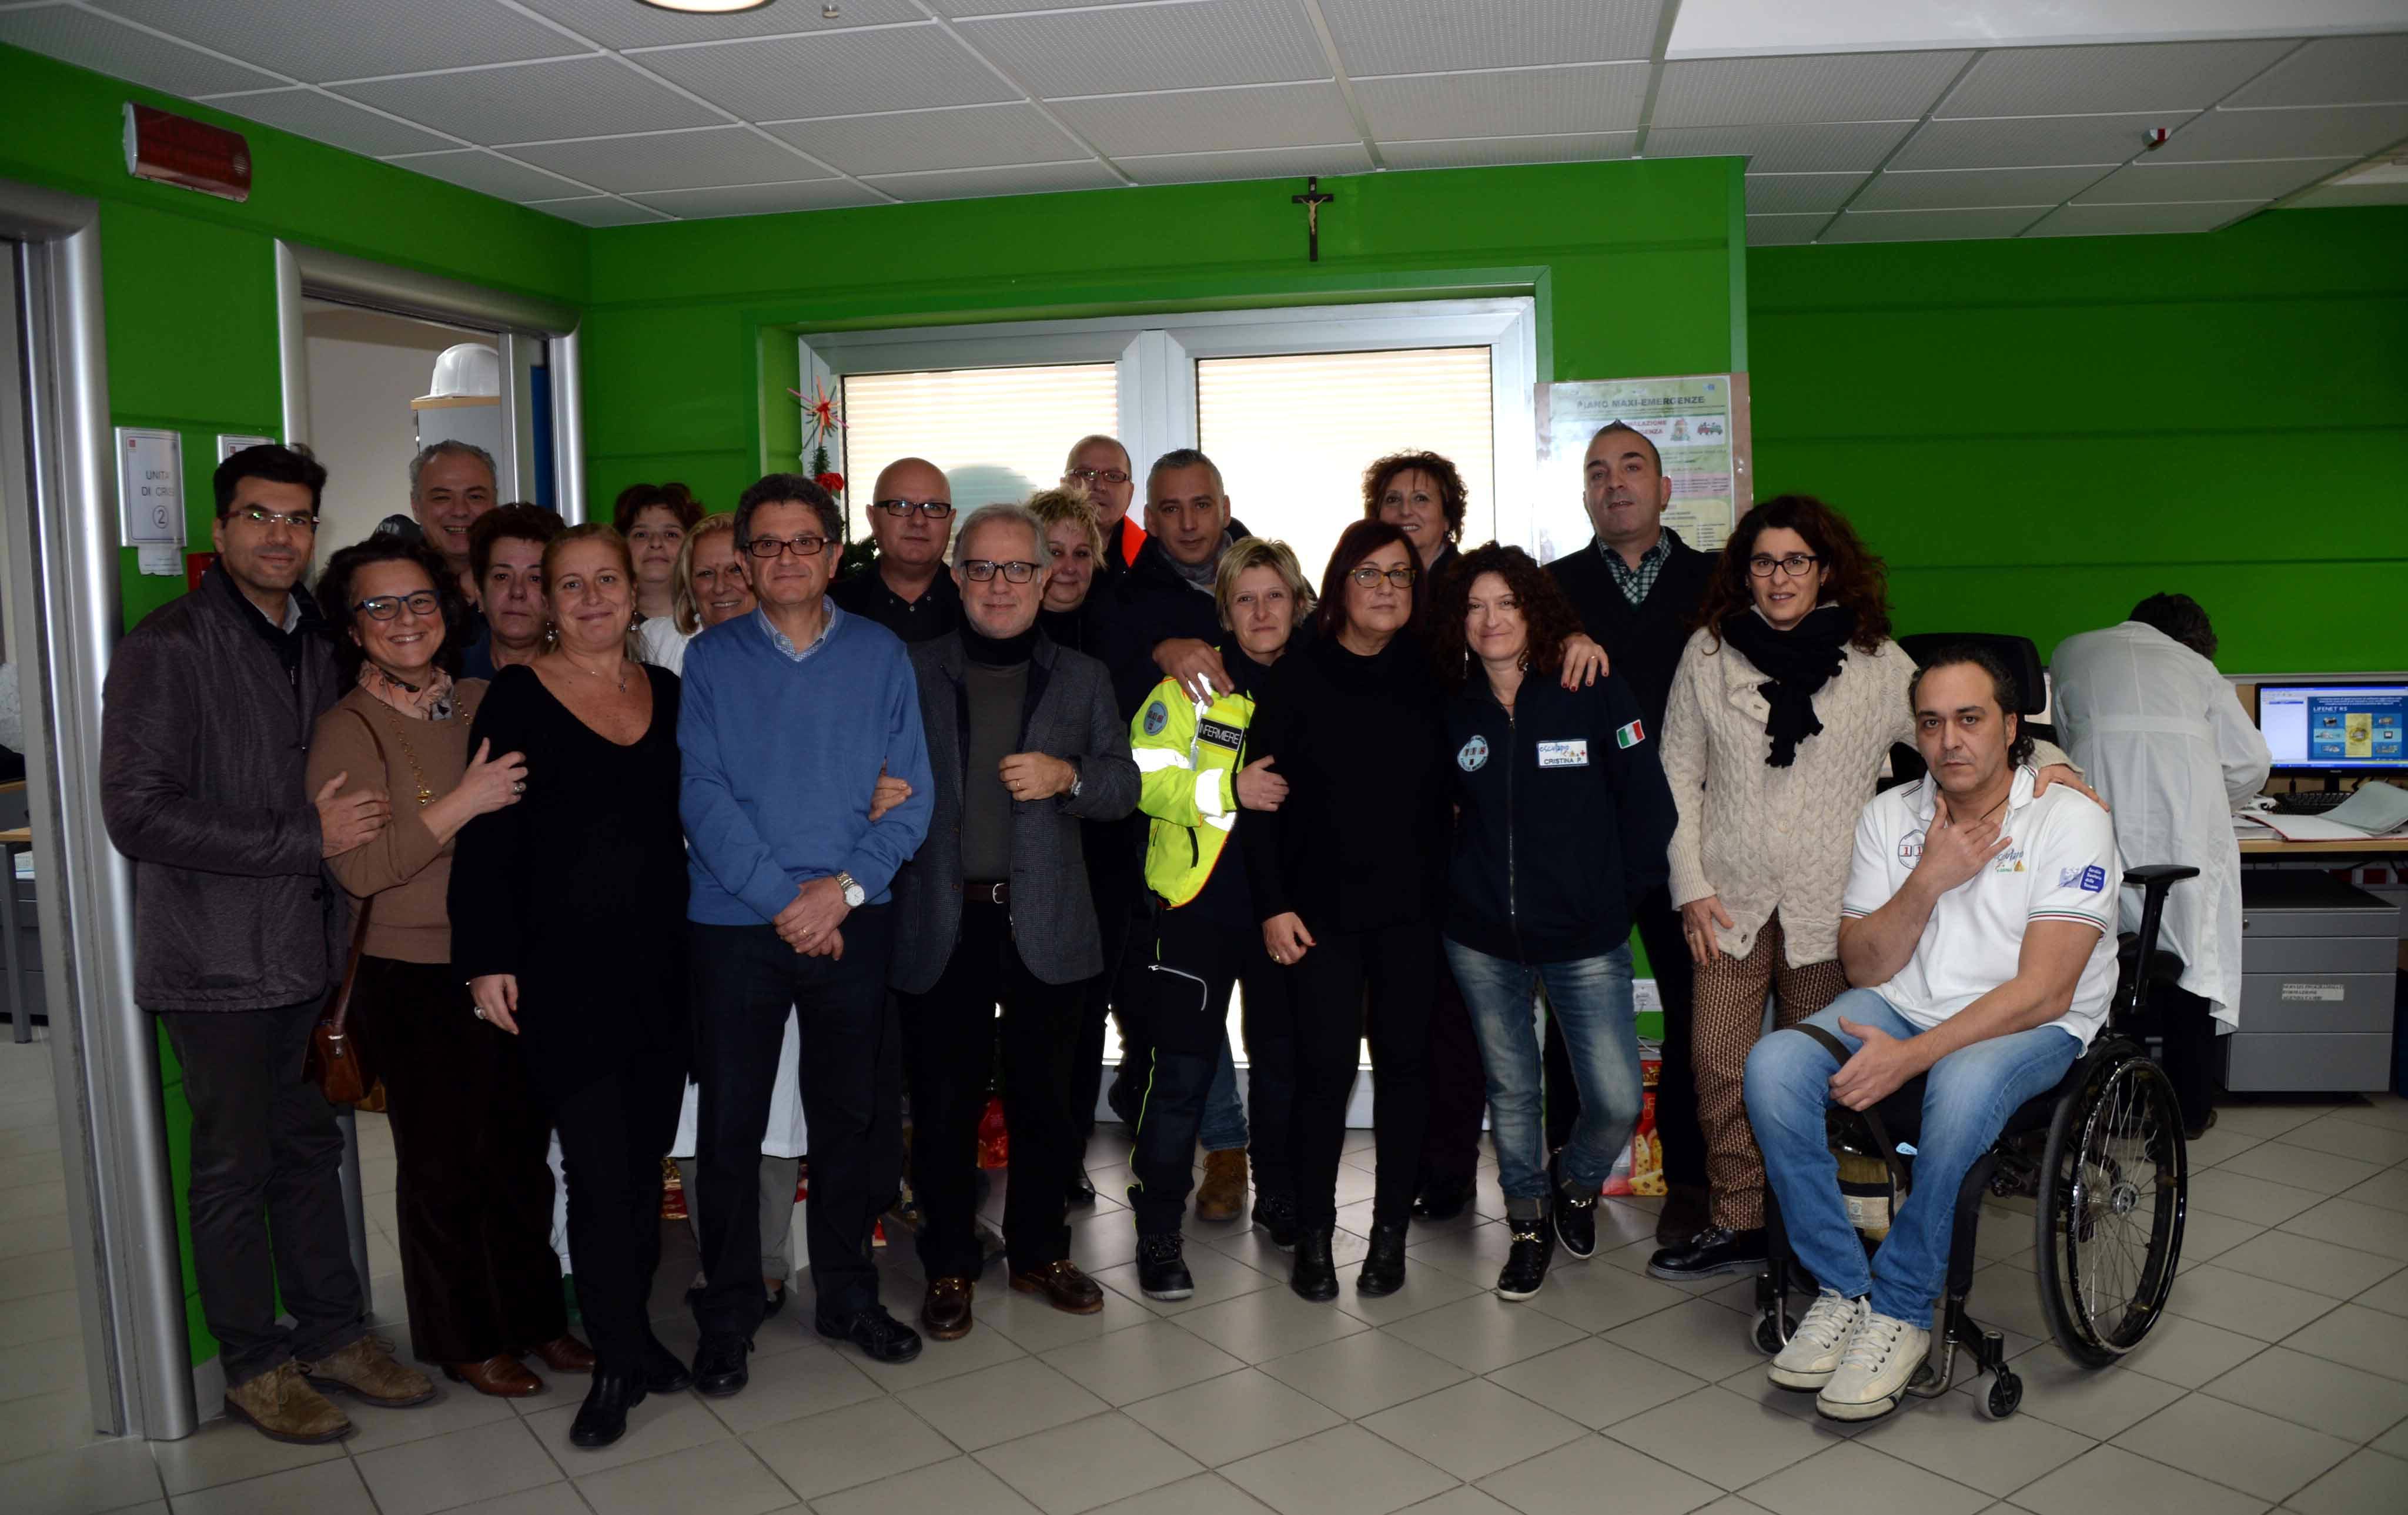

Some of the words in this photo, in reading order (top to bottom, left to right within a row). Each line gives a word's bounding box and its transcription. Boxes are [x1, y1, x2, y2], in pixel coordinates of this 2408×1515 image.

[1611, 396, 1705, 407] MAXI-EMERGENZE
[141, 487, 150, 497] DI
[159, 510, 165, 524] 2
